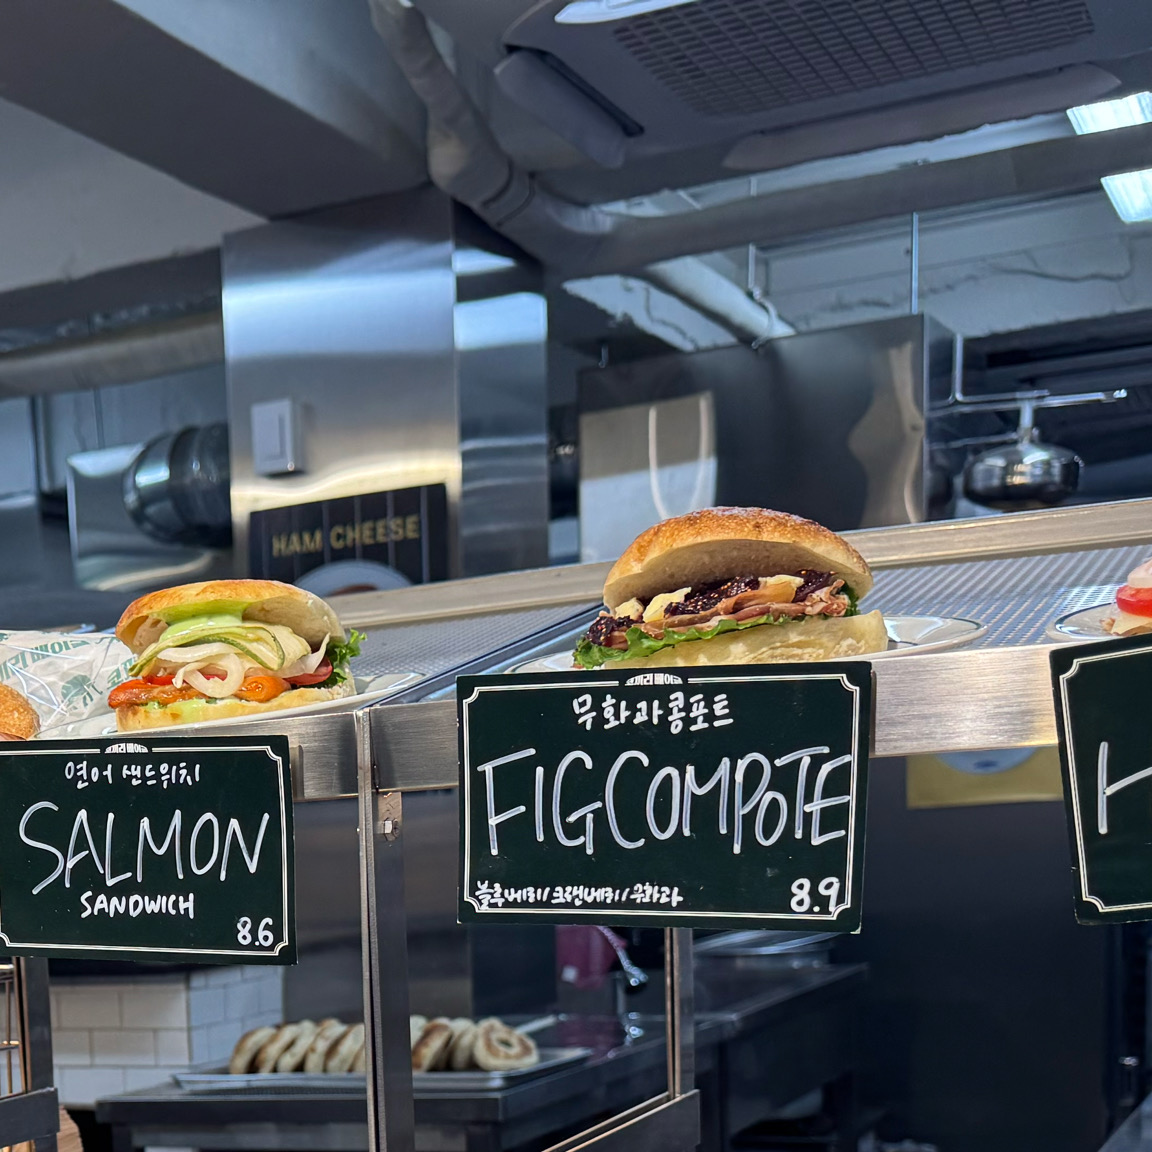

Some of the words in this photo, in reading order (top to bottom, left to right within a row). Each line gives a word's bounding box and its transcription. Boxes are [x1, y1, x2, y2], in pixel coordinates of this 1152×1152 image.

[272, 529, 323, 557] HAM
[330, 514, 421, 550] CHEESE
[64, 760, 113, 790] 연어
[122, 762, 201, 790] 샌드위치
[18, 800, 271, 895] SALMON
[80, 890, 195, 919] SANDWICH
[790, 876, 841, 914] 8.9
[236, 916, 274, 947] 8.6
